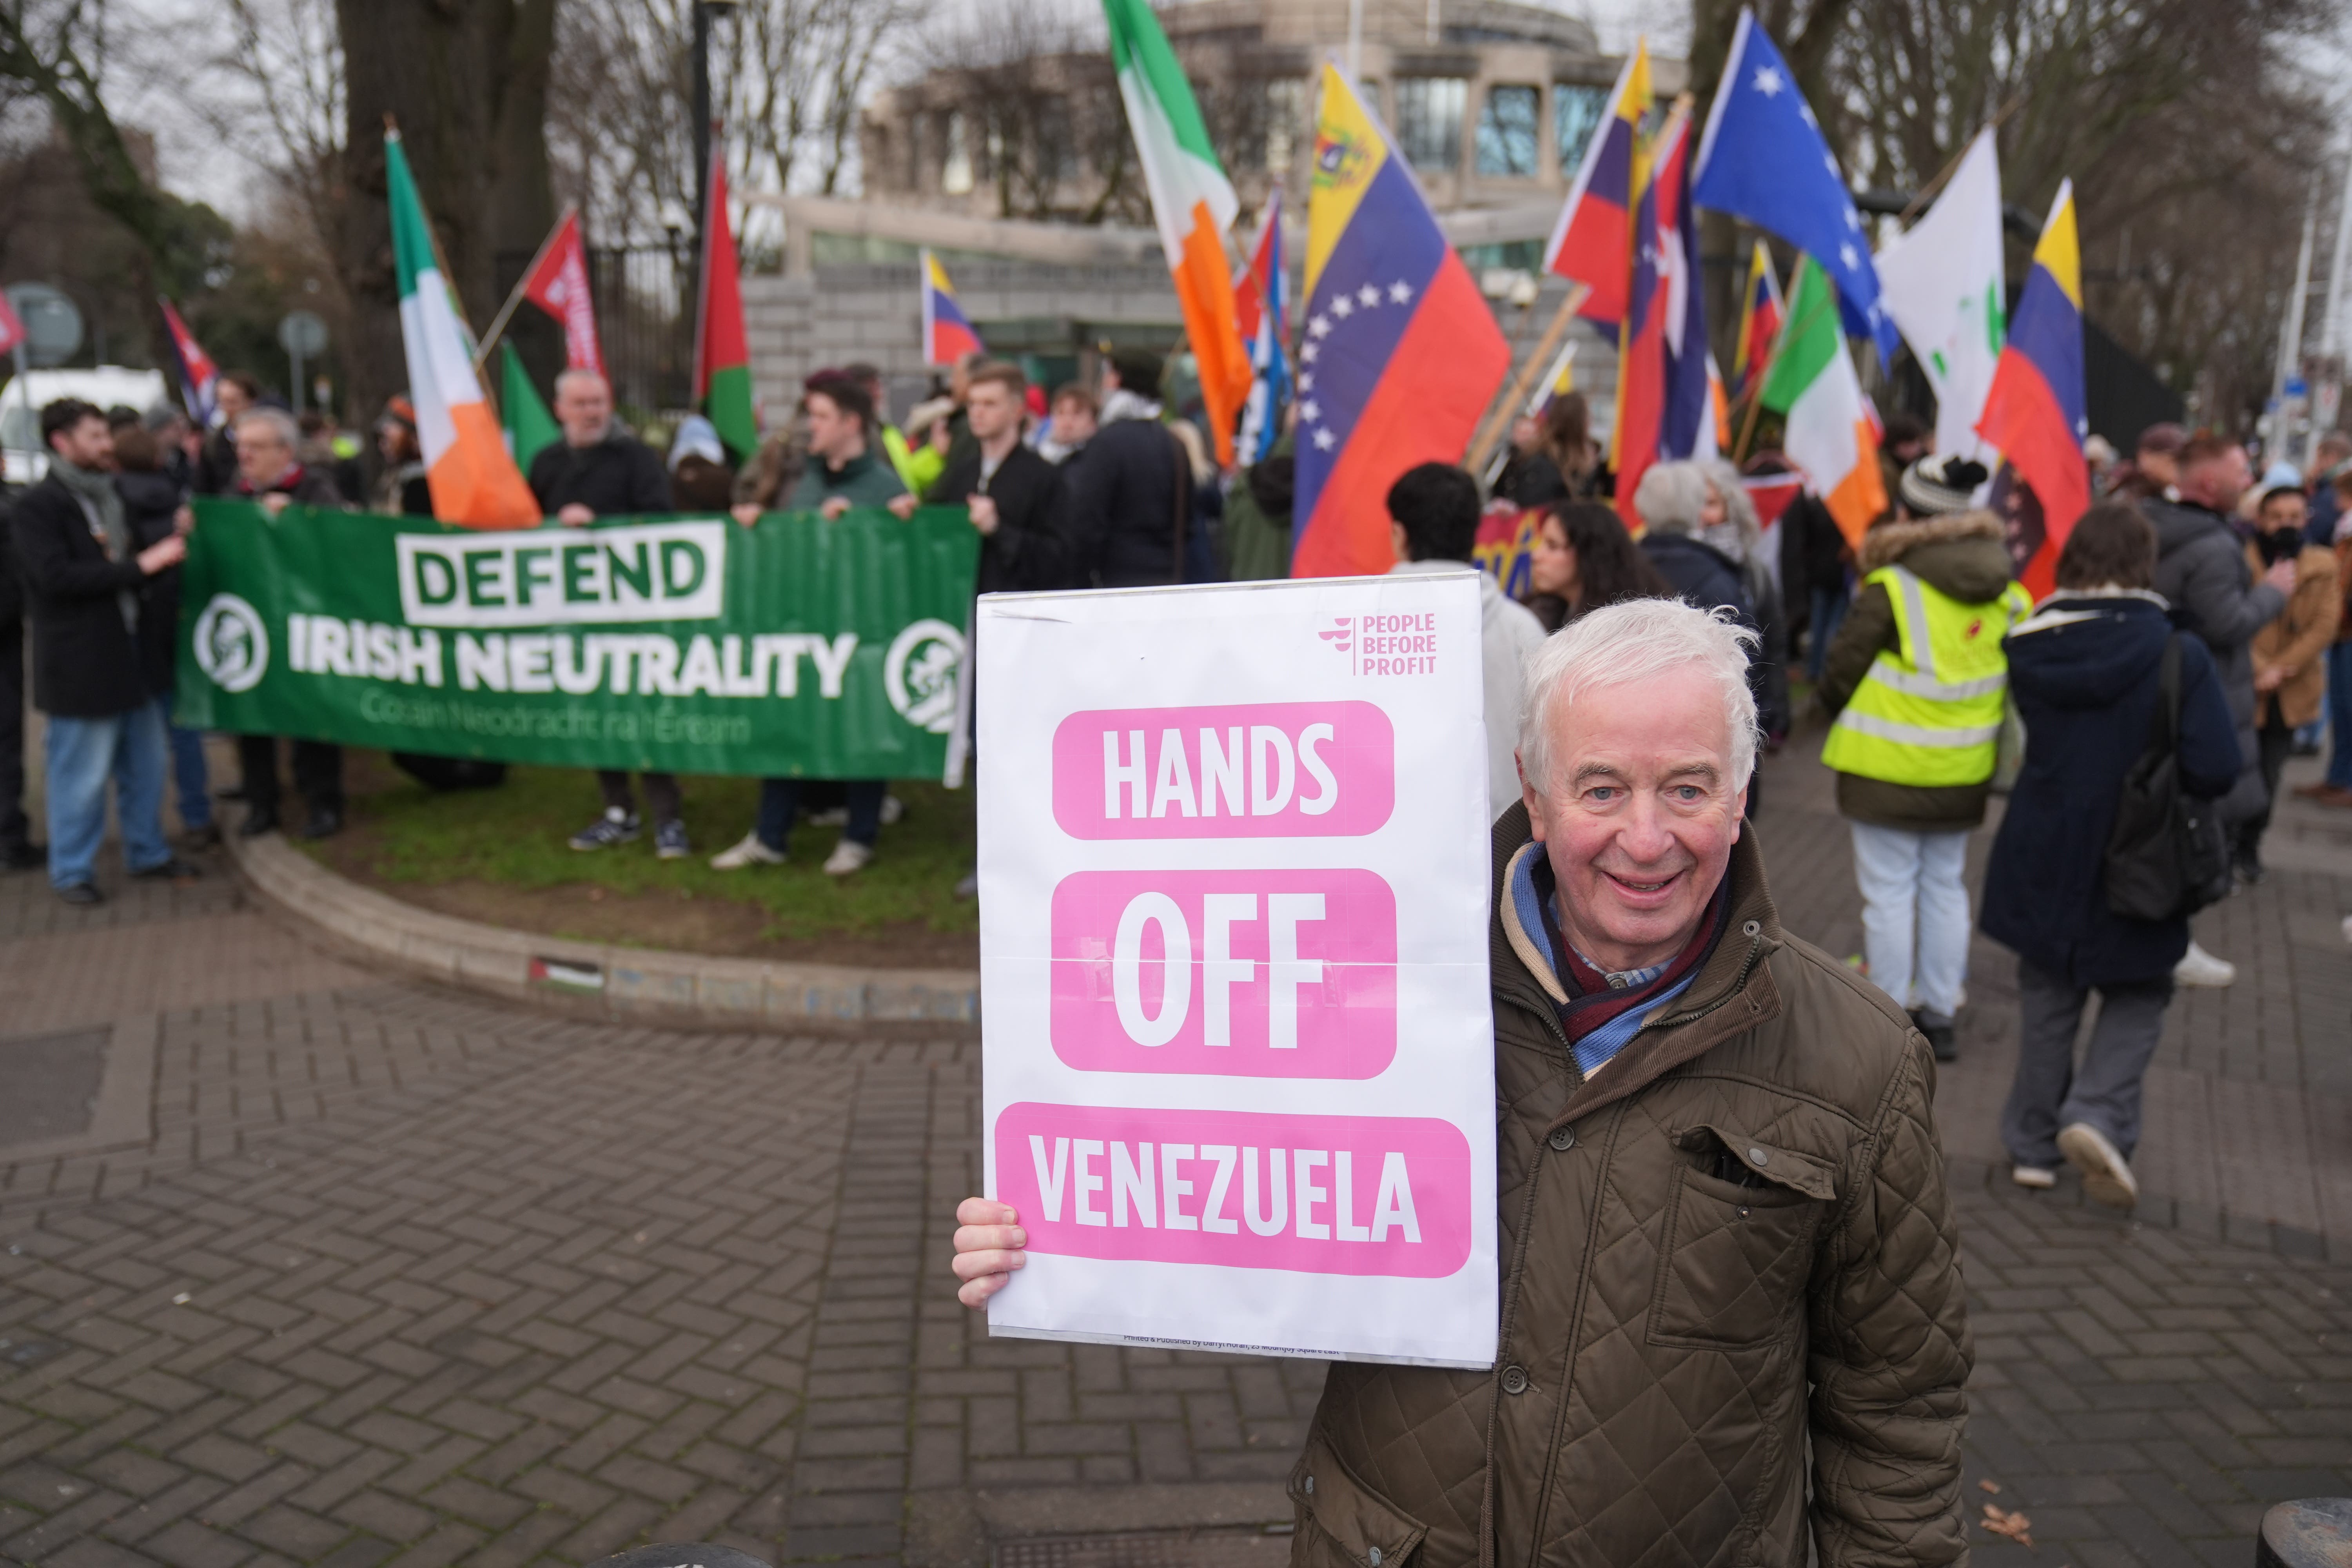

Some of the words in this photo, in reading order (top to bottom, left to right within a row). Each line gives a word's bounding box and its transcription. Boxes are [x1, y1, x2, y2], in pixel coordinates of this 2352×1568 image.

[414, 539, 706, 607] DEFEND
[287, 613, 444, 688] IRISH
[455, 632, 858, 699] NEUTRALITY
[1363, 613, 1435, 633] PEOPLE
[1363, 635, 1436, 654] BEFORE
[1363, 656, 1436, 675] PROFIT
[1103, 722, 1338, 818] HANDS
[1112, 891, 1326, 1049] OFF
[1028, 1134, 1422, 1243] VENEZUELA
